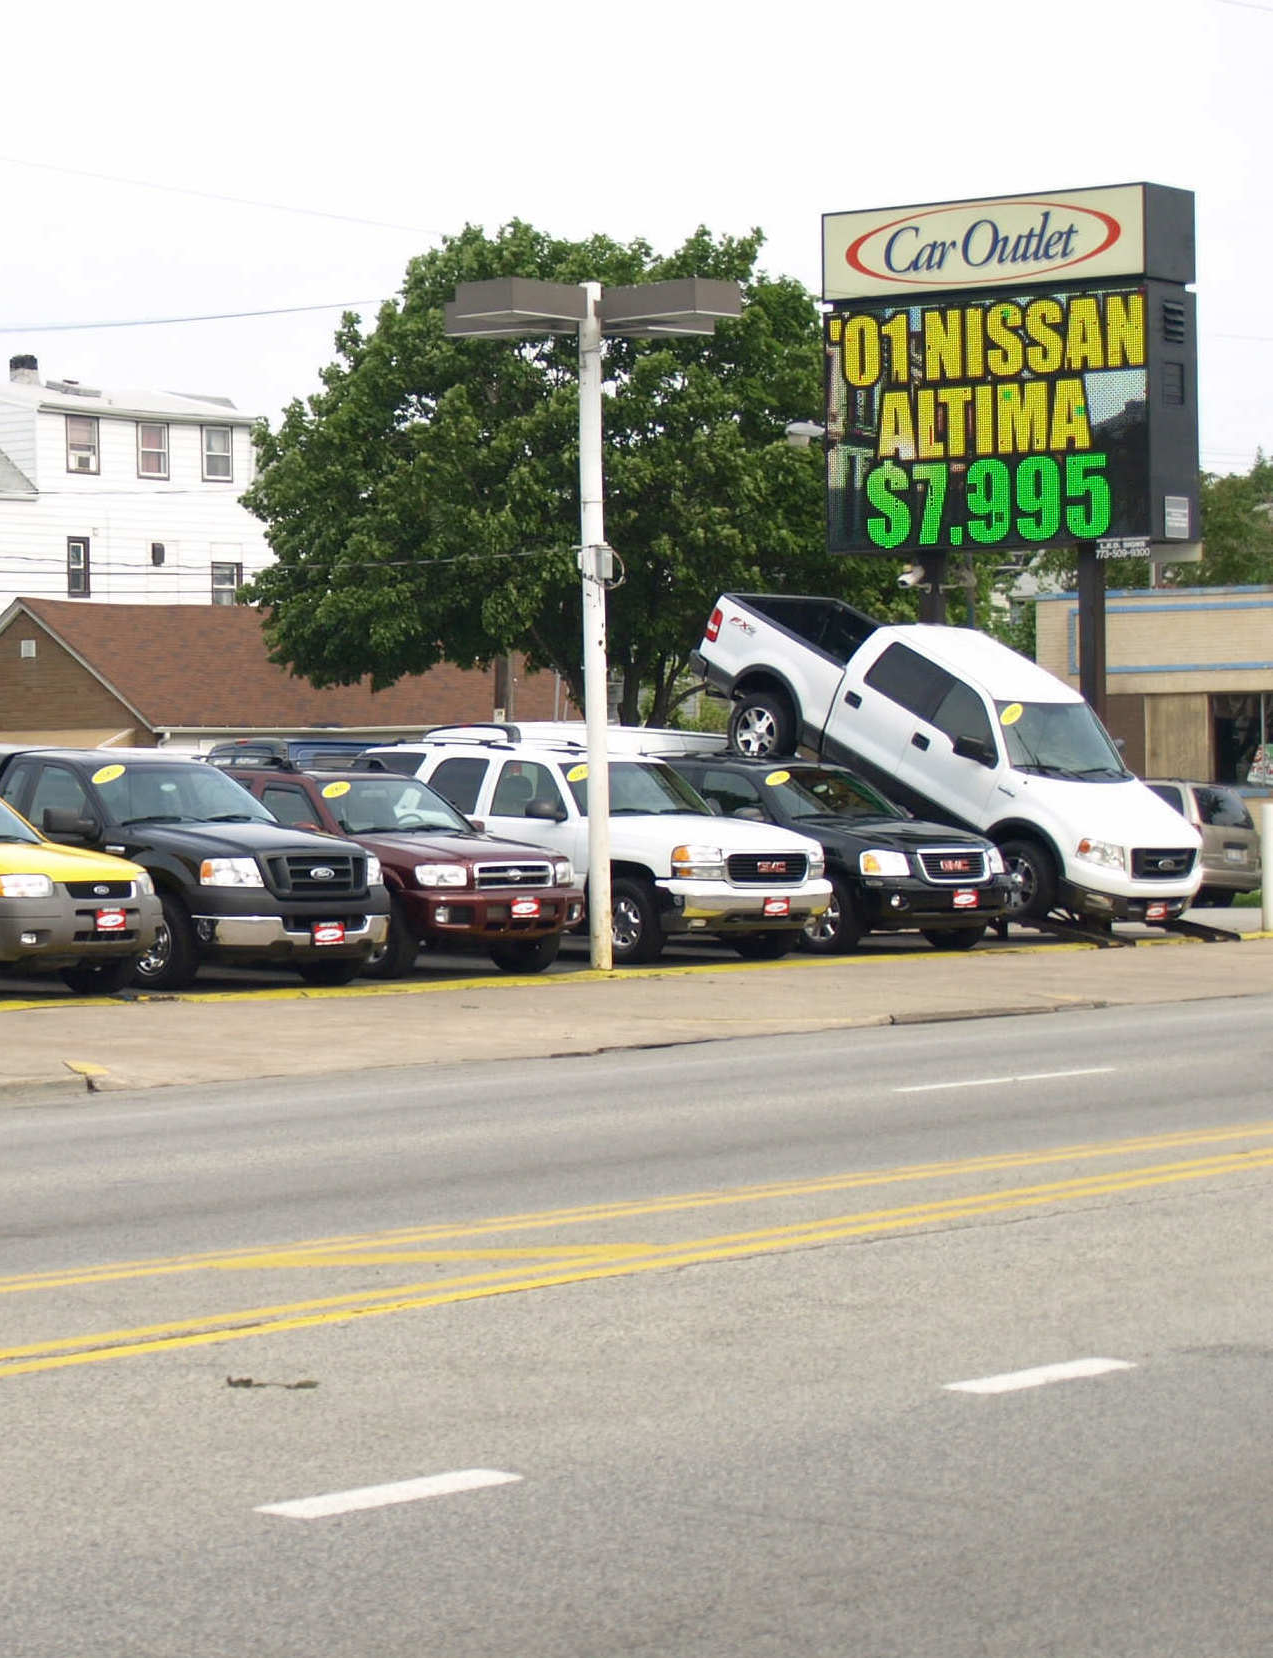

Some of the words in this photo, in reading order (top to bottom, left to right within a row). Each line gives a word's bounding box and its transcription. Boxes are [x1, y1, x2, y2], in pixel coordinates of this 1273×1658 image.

[884, 226, 957, 273] Car
[961, 211, 1078, 267] Outlet
[924, 292, 1145, 382] NISSAN
[878, 378, 1093, 461] ALTIMA
[865, 452, 1112, 549] $7.995
